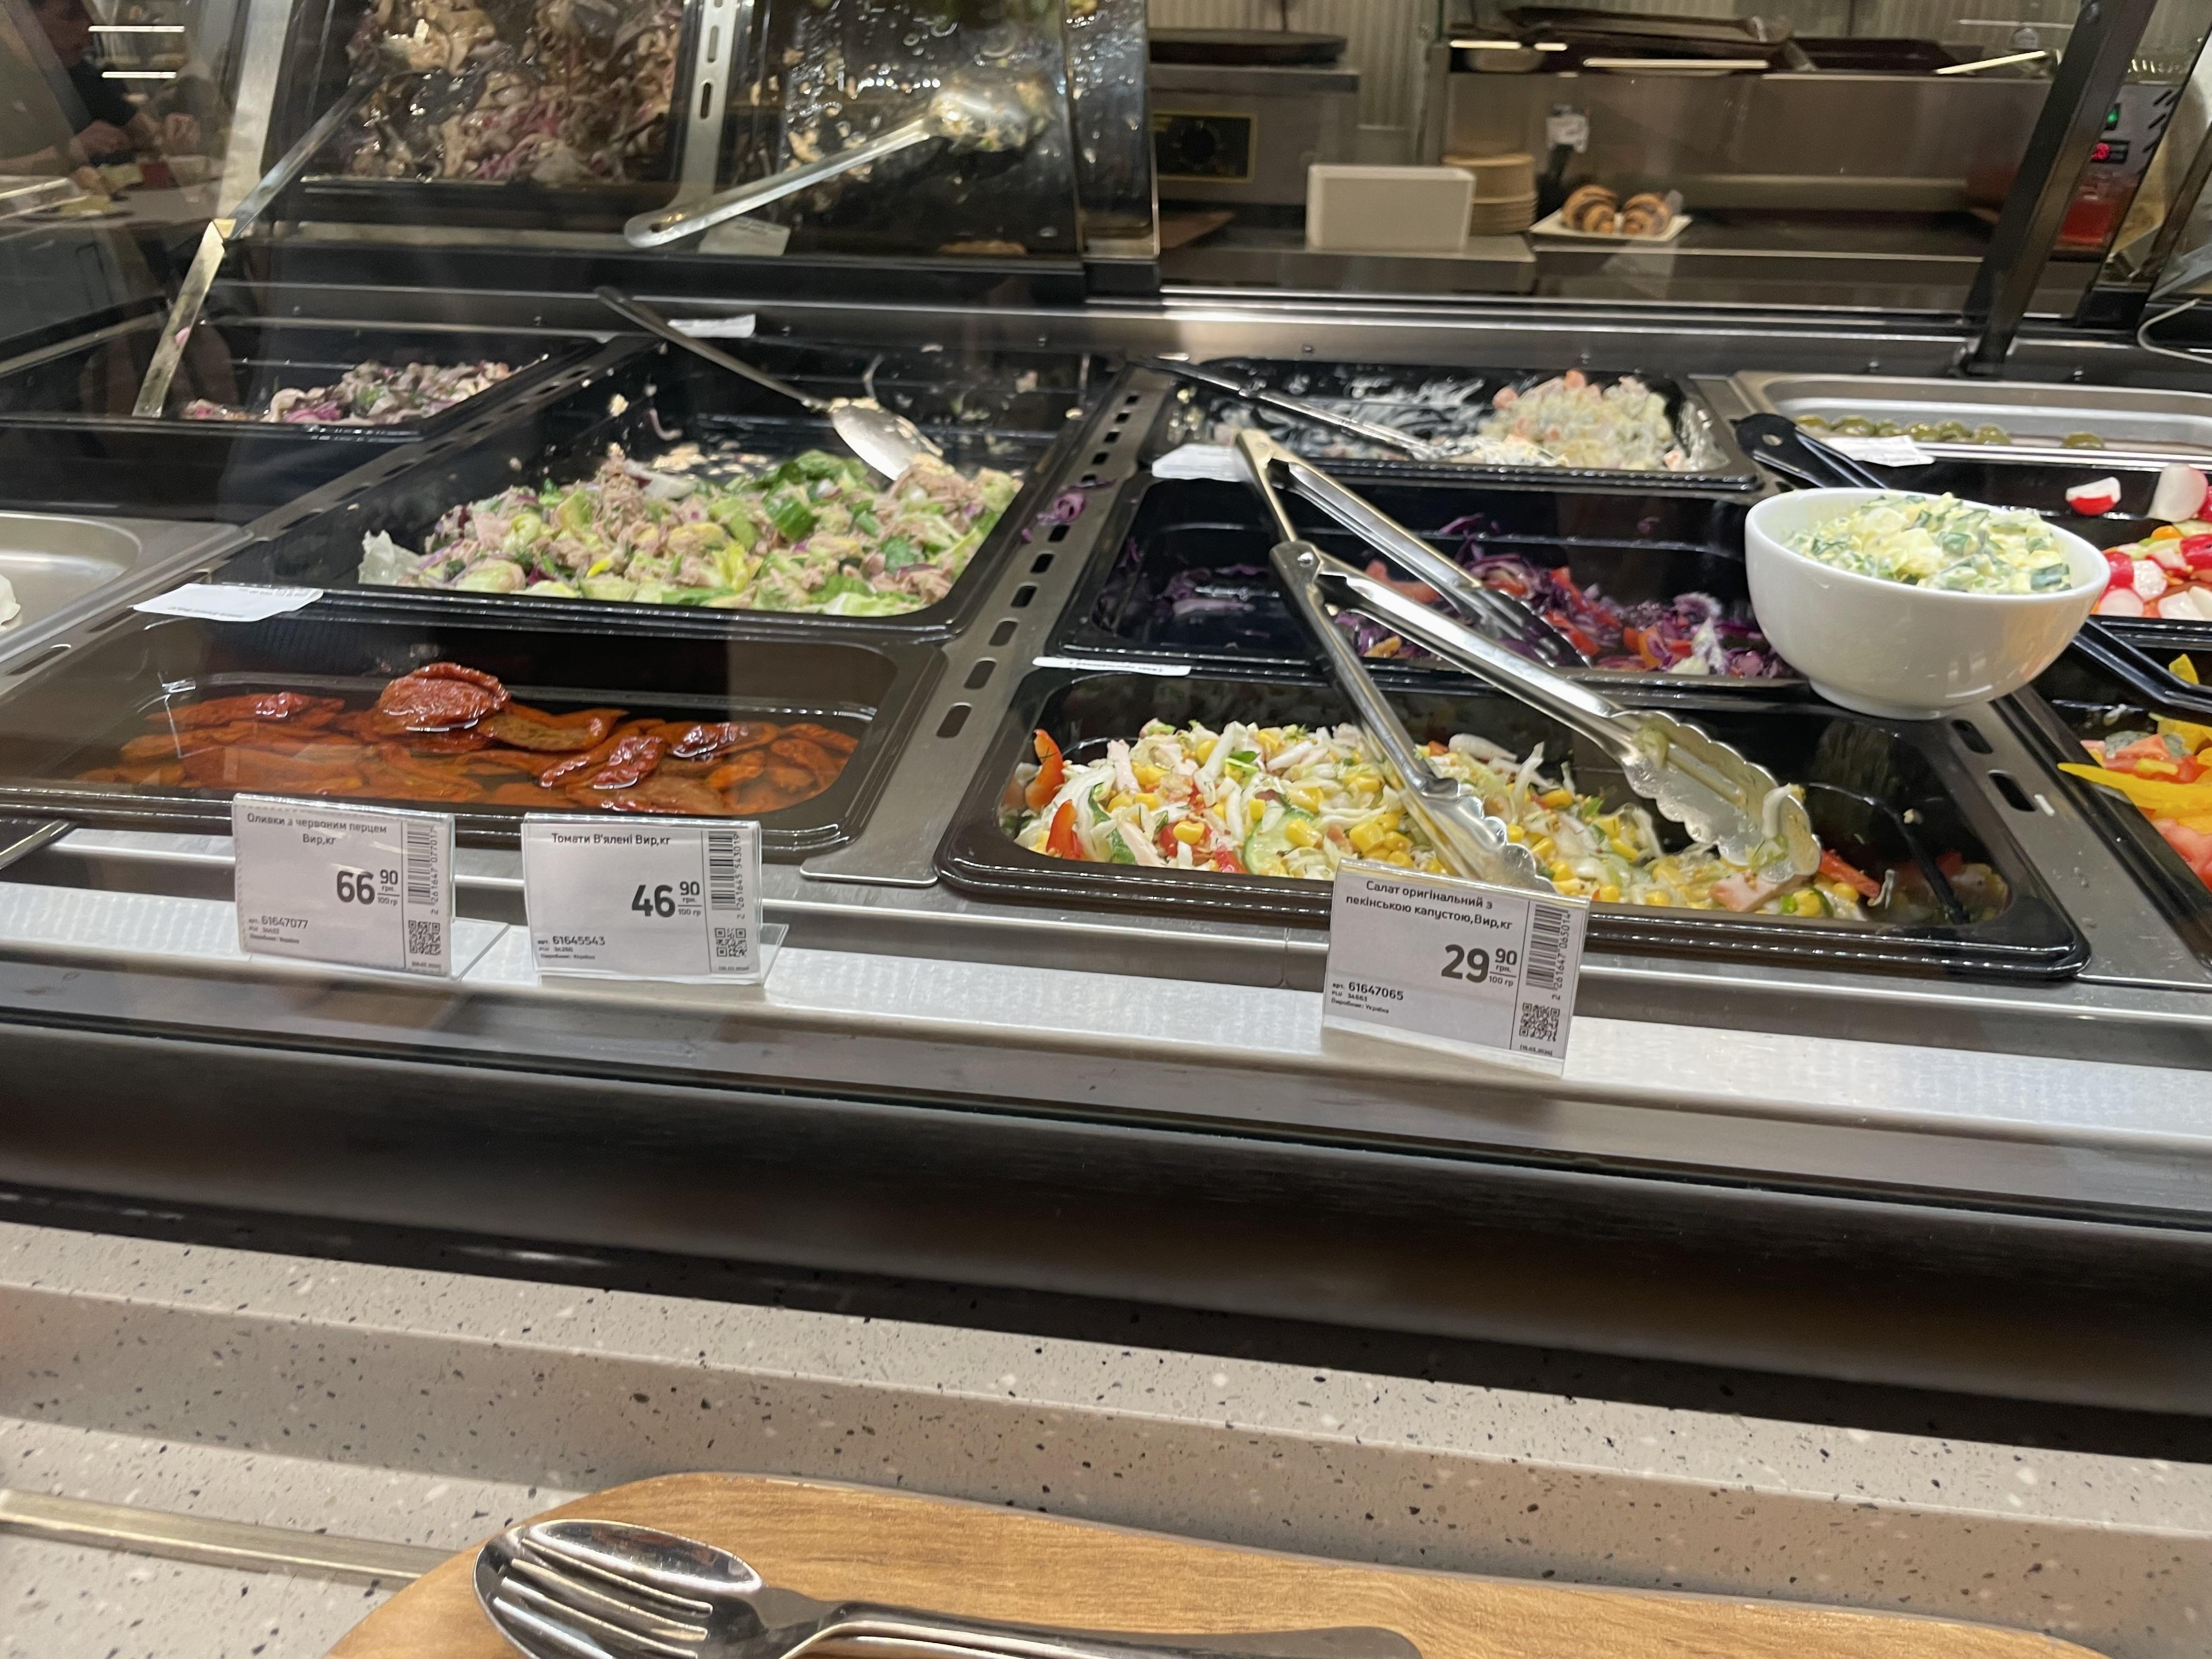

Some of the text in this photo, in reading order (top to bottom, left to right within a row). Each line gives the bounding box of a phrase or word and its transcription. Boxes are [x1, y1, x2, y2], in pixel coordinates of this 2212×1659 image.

[247, 812, 285, 826] Оливки
[349, 822, 387, 835] перцем
[303, 833, 336, 847] Вир,кг
[552, 833, 670, 847] Томати В'ялені Вир,кг
[336, 869, 398, 905] 66 90
[1367, 880, 1493, 910] Салат оригінальний з
[631, 881, 700, 917] 46 90
[1346, 895, 1412, 913] пекінською
[552, 935, 606, 946] 61645543
[1441, 944, 1517, 983] 29 90
[1348, 981, 1404, 1001] 61647065
[1488, 975, 1514, 988] 100 гр
